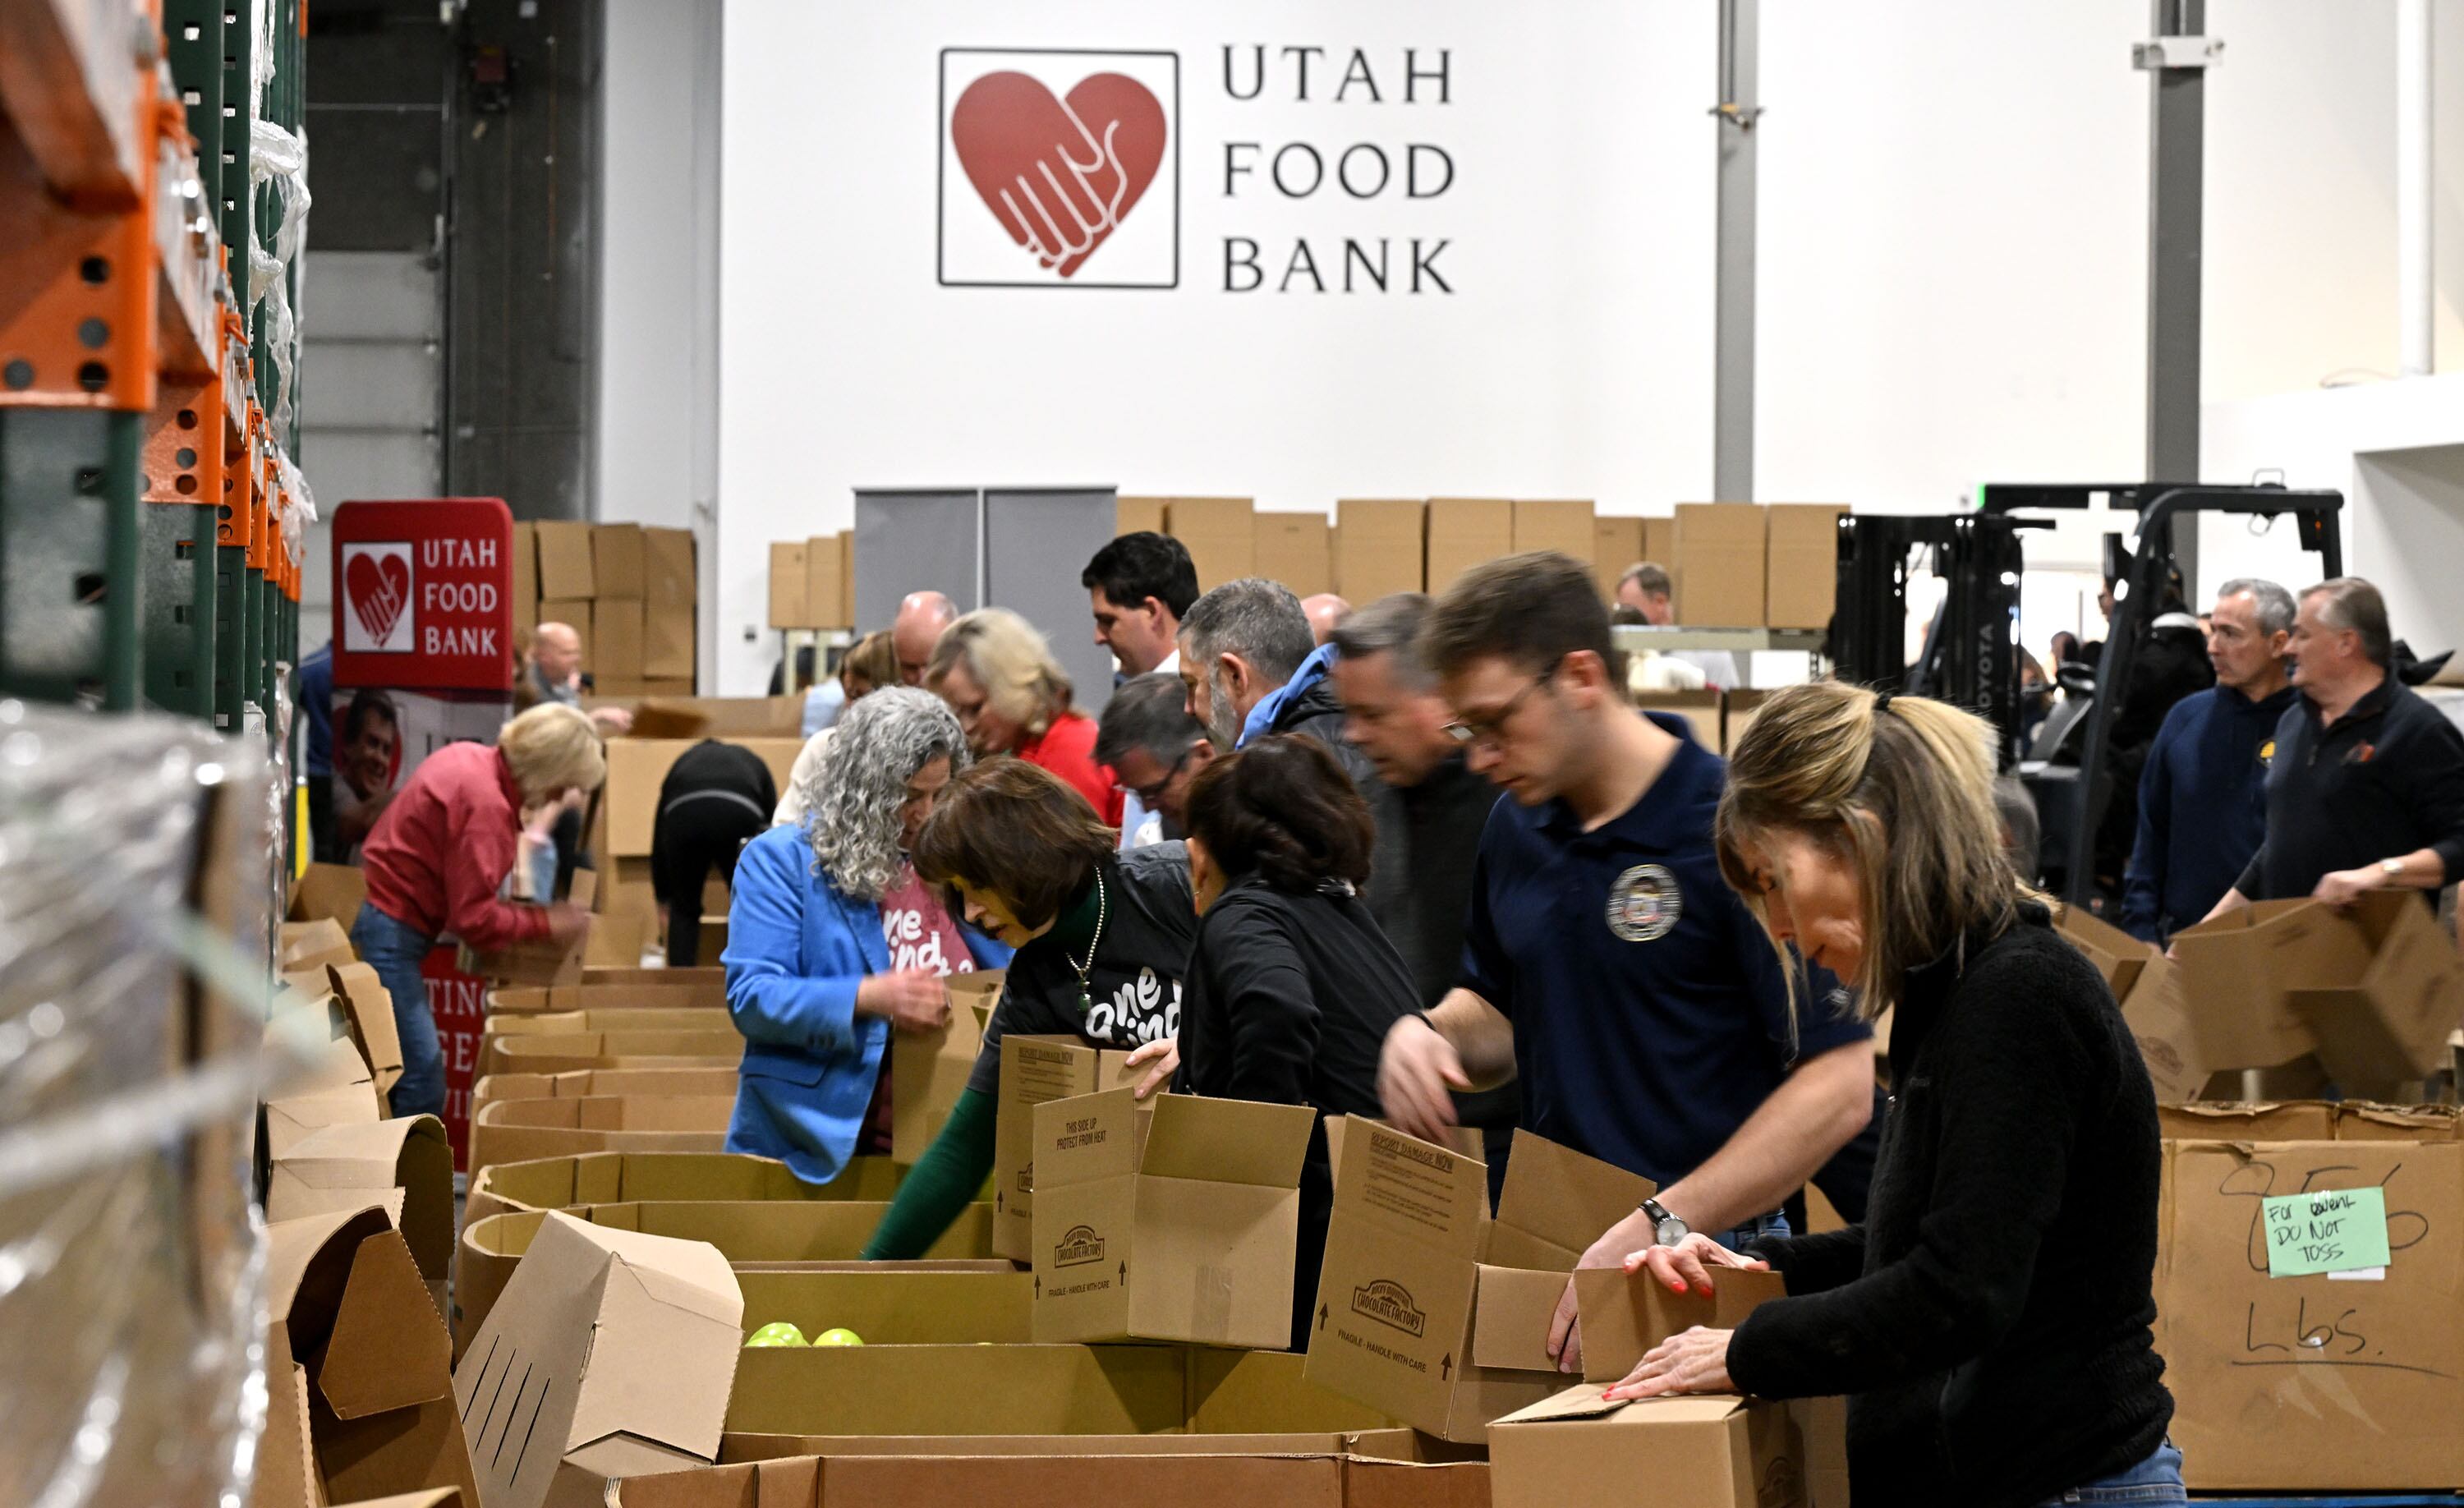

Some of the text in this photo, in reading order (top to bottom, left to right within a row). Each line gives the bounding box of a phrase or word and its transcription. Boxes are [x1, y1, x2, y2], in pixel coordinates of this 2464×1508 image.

[1222, 44, 1453, 104] UTAH
[1223, 142, 1455, 200] FOOD
[1223, 237, 1454, 294] BANK
[423, 539, 497, 568] UTAH
[425, 582, 498, 613] FOOD
[425, 626, 499, 656] BANK
[1976, 623, 1993, 709] OYOTA
[883, 909, 922, 941] ne
[1056, 1130, 1106, 1151] PROTECT FROM HEAT
[1066, 1117, 1097, 1135] THIS SIDE UP
[2268, 1204, 2292, 1223] For
[2273, 1217, 2347, 1246] DO NOT
[2296, 1243, 2345, 1262] TOSS
[1048, 1287, 1066, 1298] FRAGILE
[1069, 1284, 1086, 1294] HANDLE
[1087, 1281, 1097, 1292] WITH
[1097, 1280, 1110, 1290] CARE
[1357, 1292, 1421, 1331] CHOCOLATE FACTORY
[1337, 1328, 1363, 1348] FRAGILE
[1366, 1341, 1392, 1359] HANDLE
[1392, 1351, 1409, 1368] WITH
[1409, 1359, 1427, 1373] CARE
